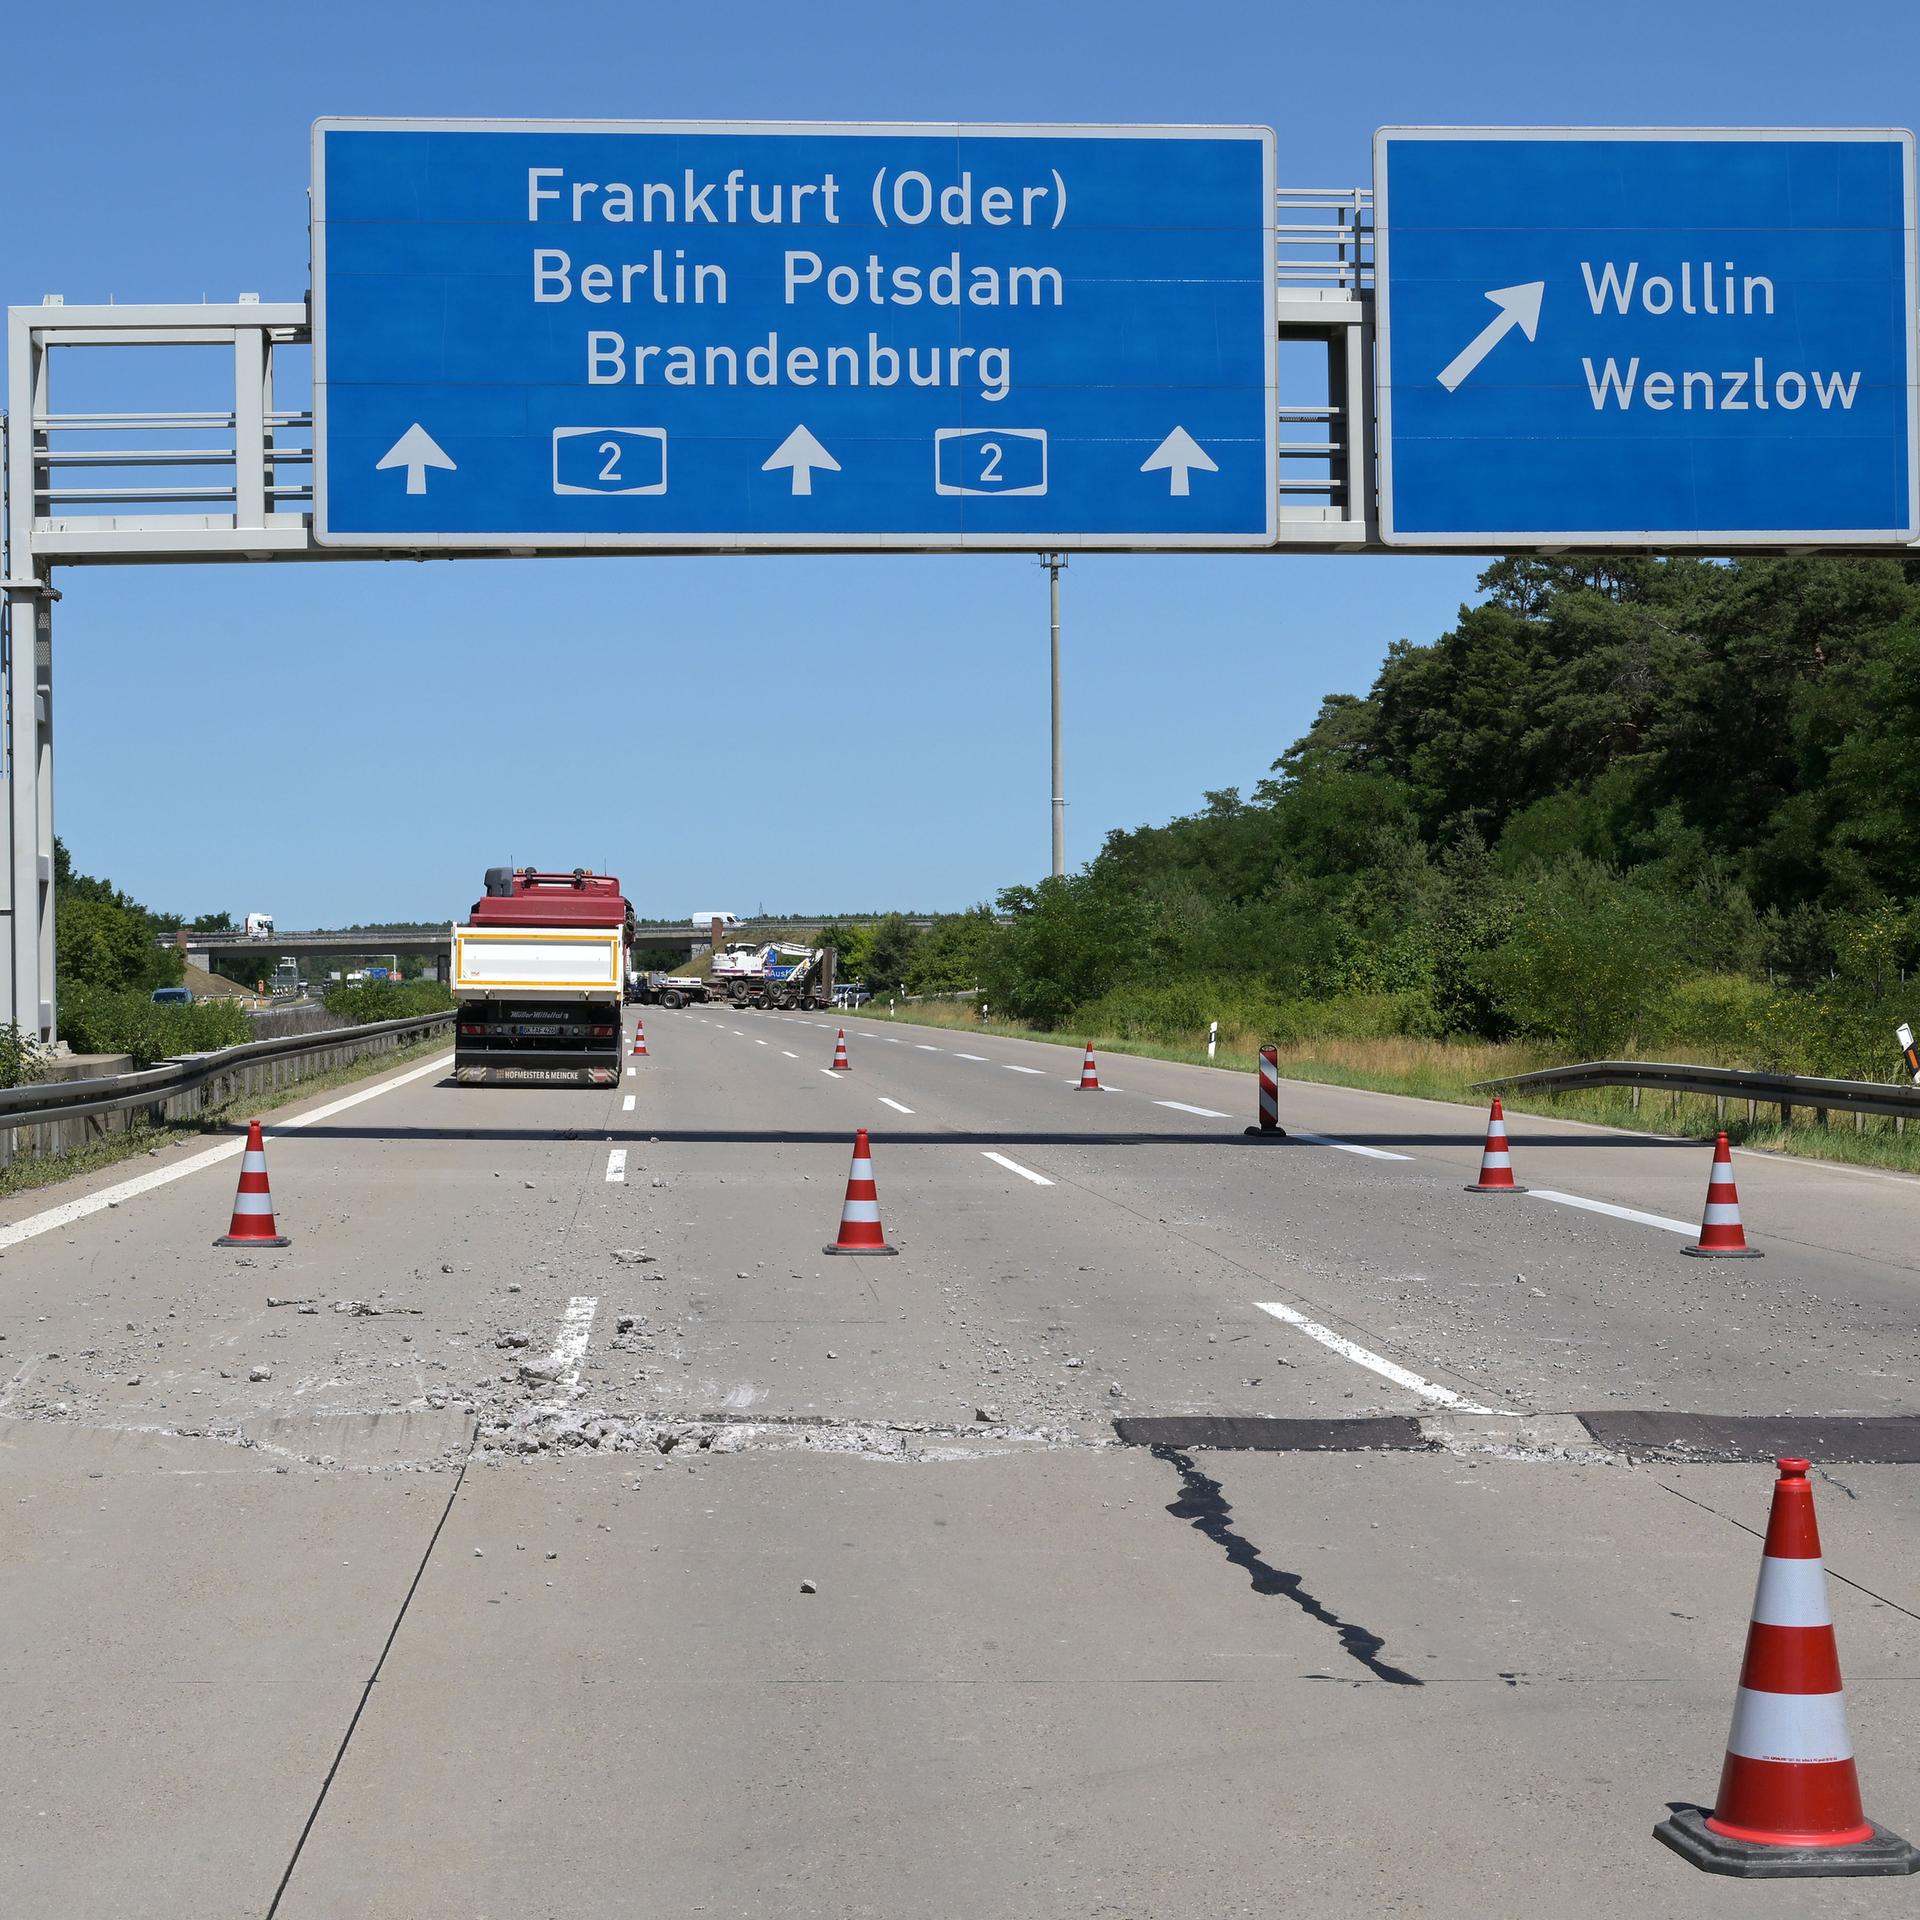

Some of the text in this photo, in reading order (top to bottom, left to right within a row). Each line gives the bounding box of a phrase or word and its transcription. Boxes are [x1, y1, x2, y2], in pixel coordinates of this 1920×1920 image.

[528, 166, 1067, 230] Frankfurt (Oder)
[533, 248, 1063, 306] Berlin Potsdam
[1580, 261, 1774, 315] Wollin
[587, 330, 1010, 402] Brandenburg
[1582, 357, 1861, 411] Wenzlow
[598, 441, 622, 481] 2
[980, 442, 1003, 482] 2
[504, 1071, 579, 1080] HOFMEISTER & MEINCKE
